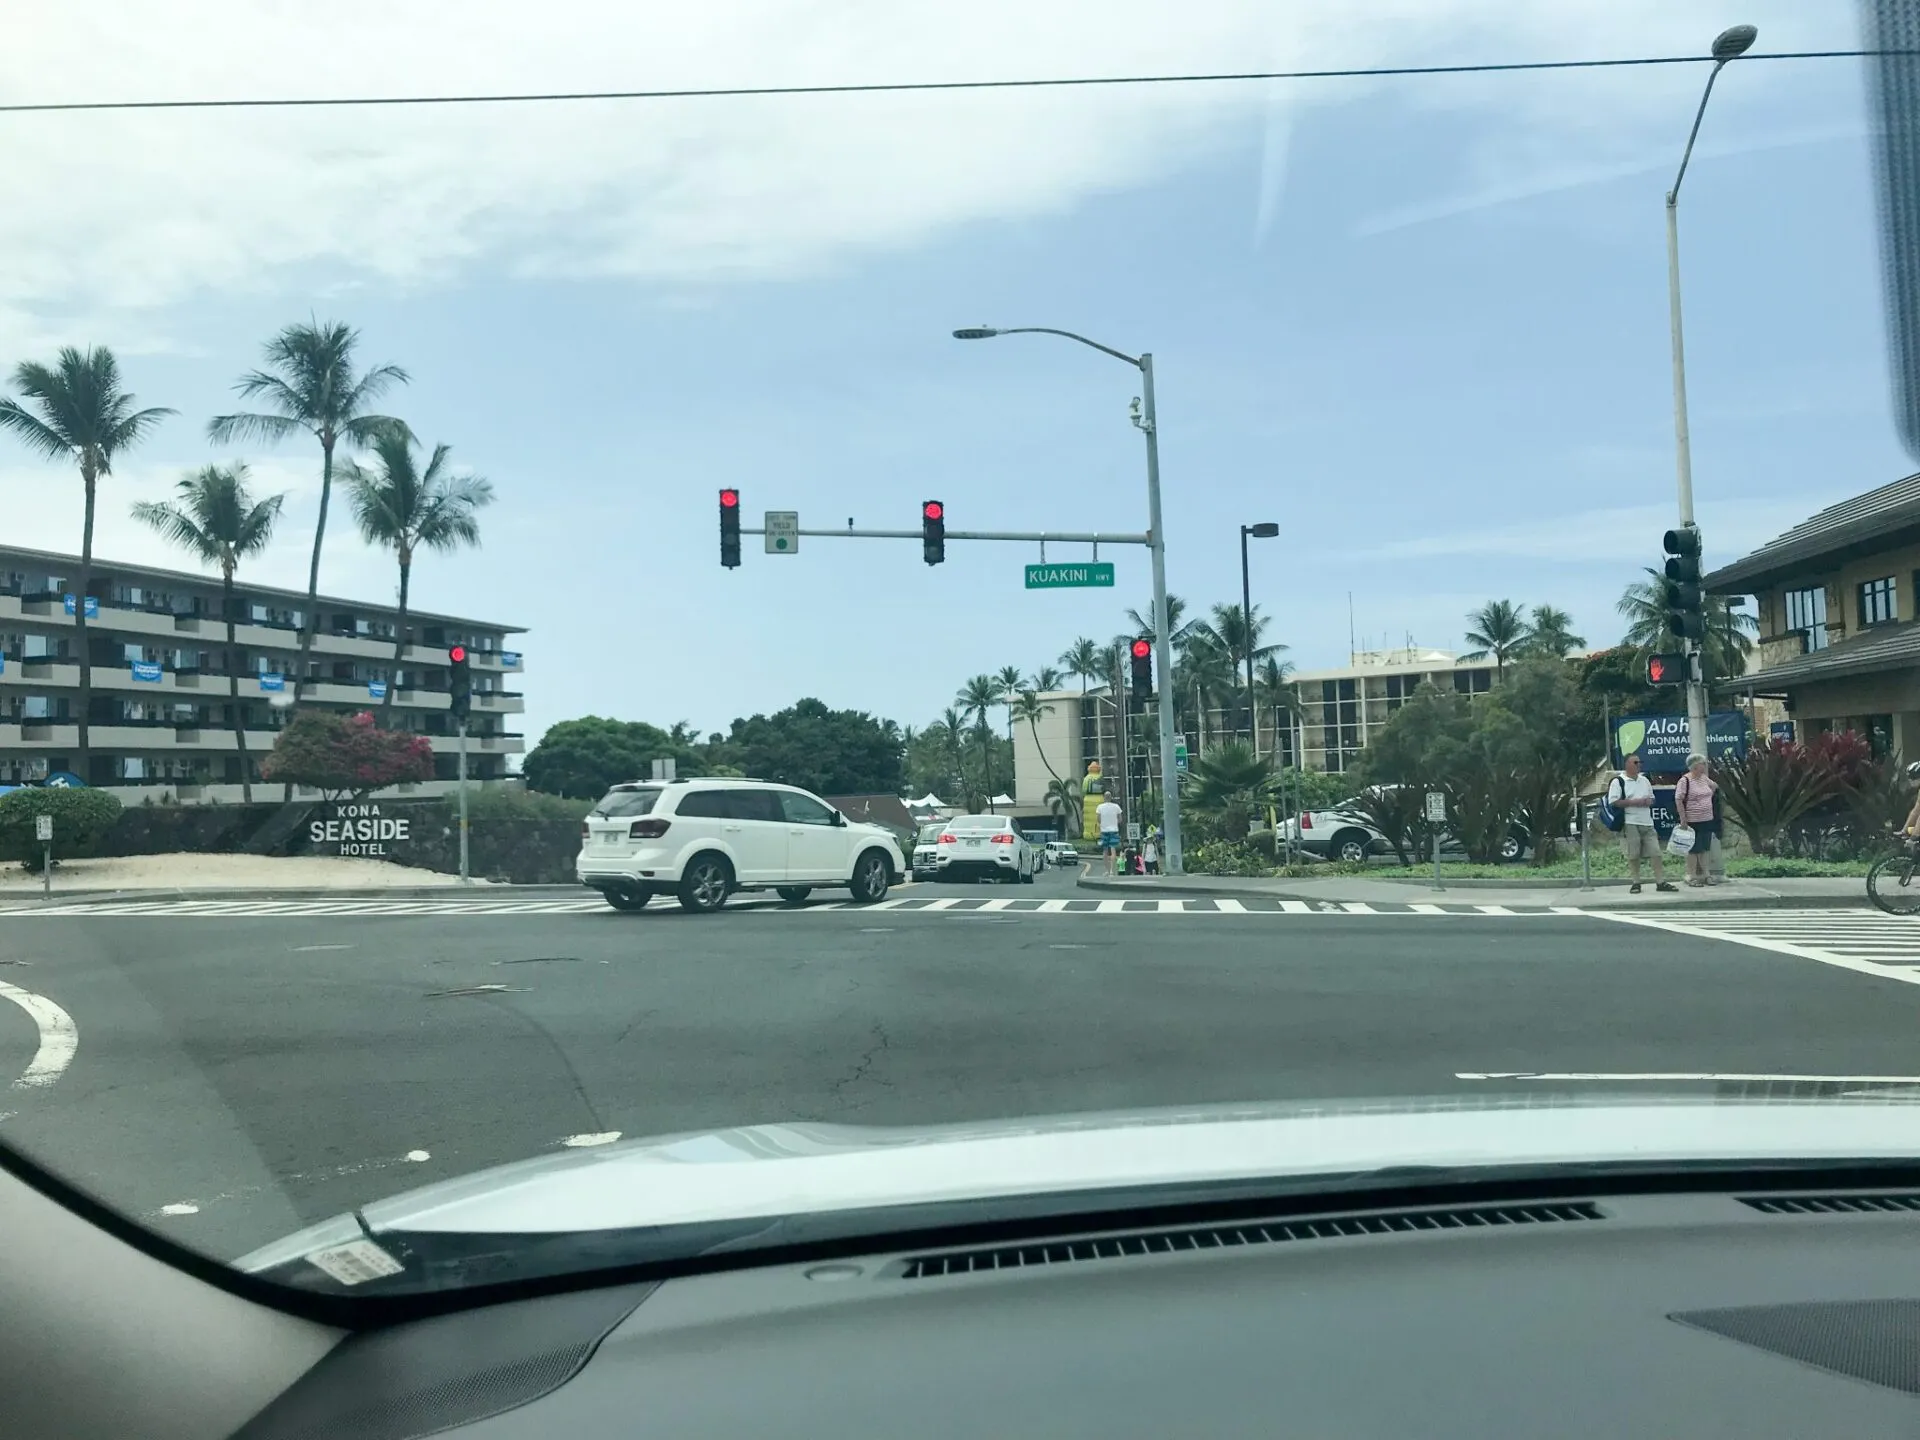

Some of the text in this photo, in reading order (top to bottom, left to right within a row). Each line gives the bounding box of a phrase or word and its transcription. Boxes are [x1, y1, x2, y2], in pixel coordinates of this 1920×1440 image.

[1029, 569, 1110, 583] KUAKINI HWY
[1646, 717, 1689, 735] Aloh
[1706, 734, 1739, 743] thletes
[1647, 746, 1691, 755] and Visito
[337, 804, 380, 817] KONA
[310, 819, 410, 842] SEASIDE
[340, 843, 386, 856] HOTEL
